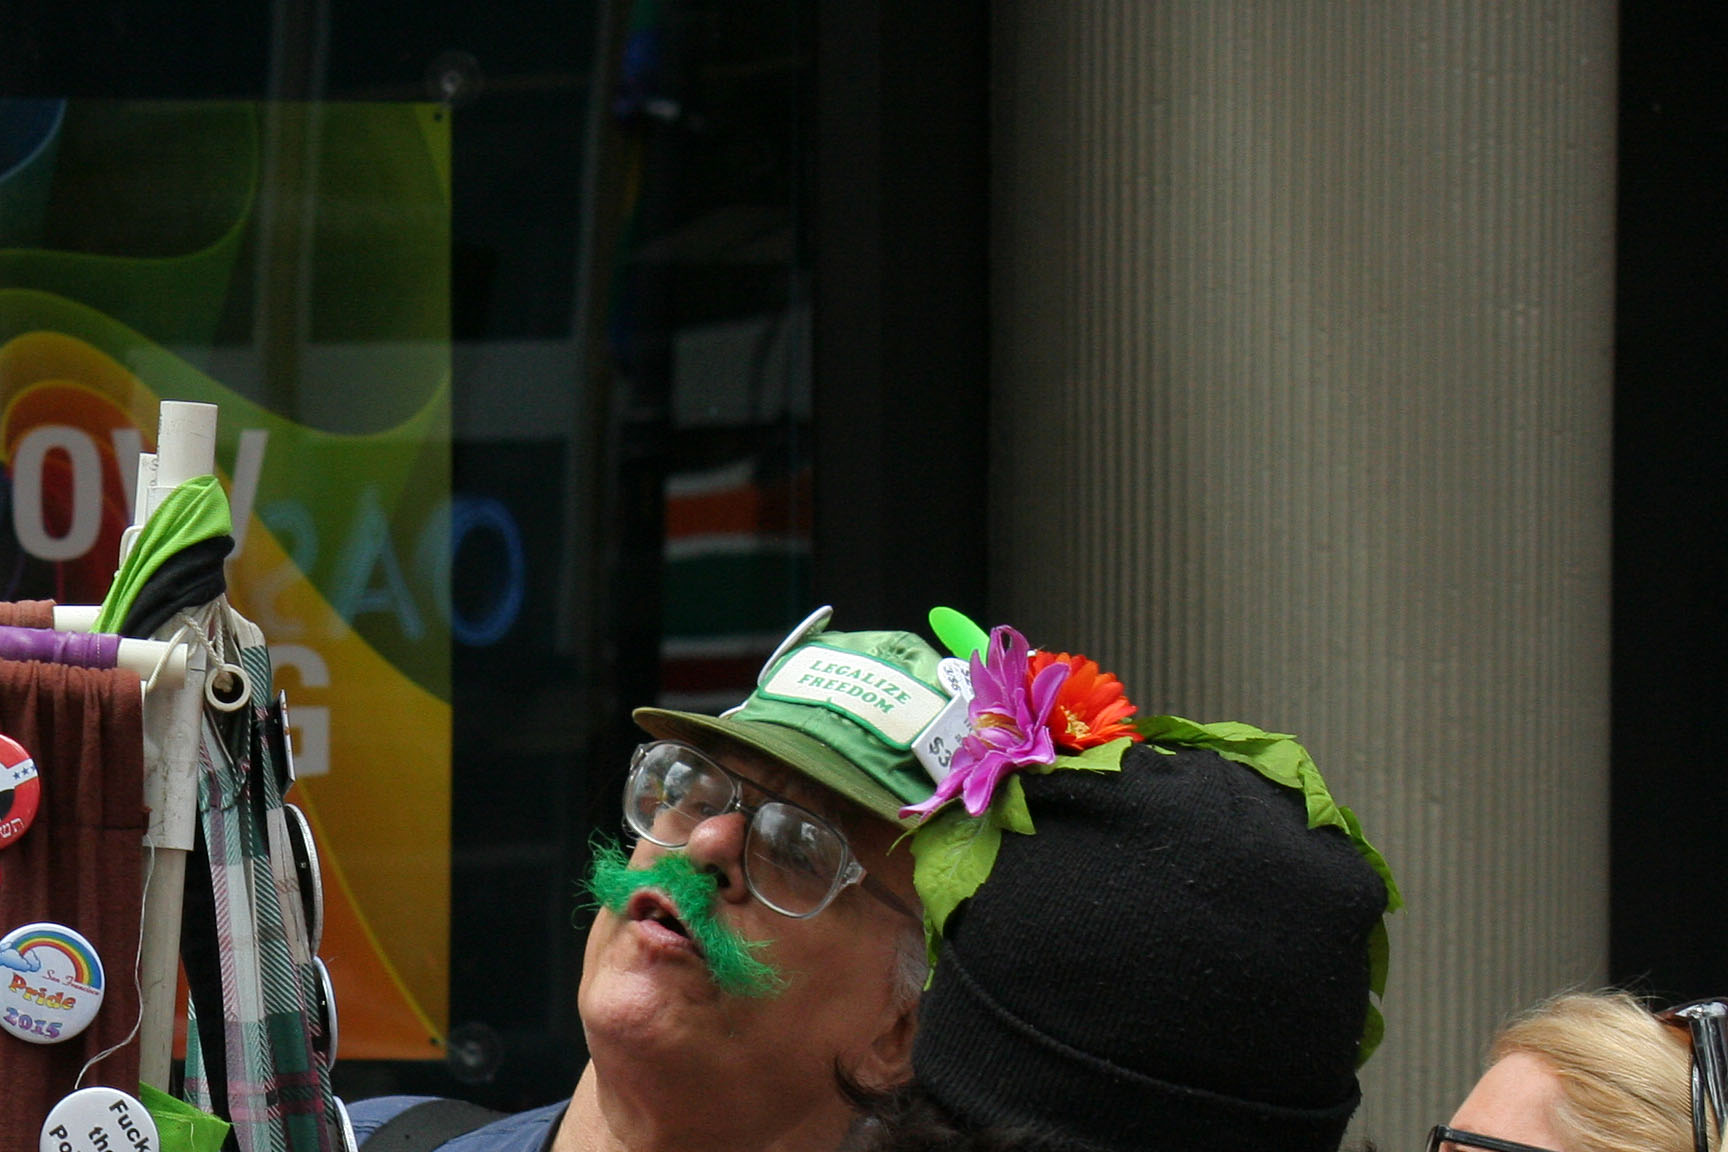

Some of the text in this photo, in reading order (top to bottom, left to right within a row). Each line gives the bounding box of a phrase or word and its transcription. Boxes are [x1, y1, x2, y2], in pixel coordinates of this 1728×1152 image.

[797, 674, 896, 714] FREEDOM
[809, 660, 911, 705] LEGALIZE
[9, 972, 77, 1011] Pride
[3, 1007, 63, 1039] 2015
